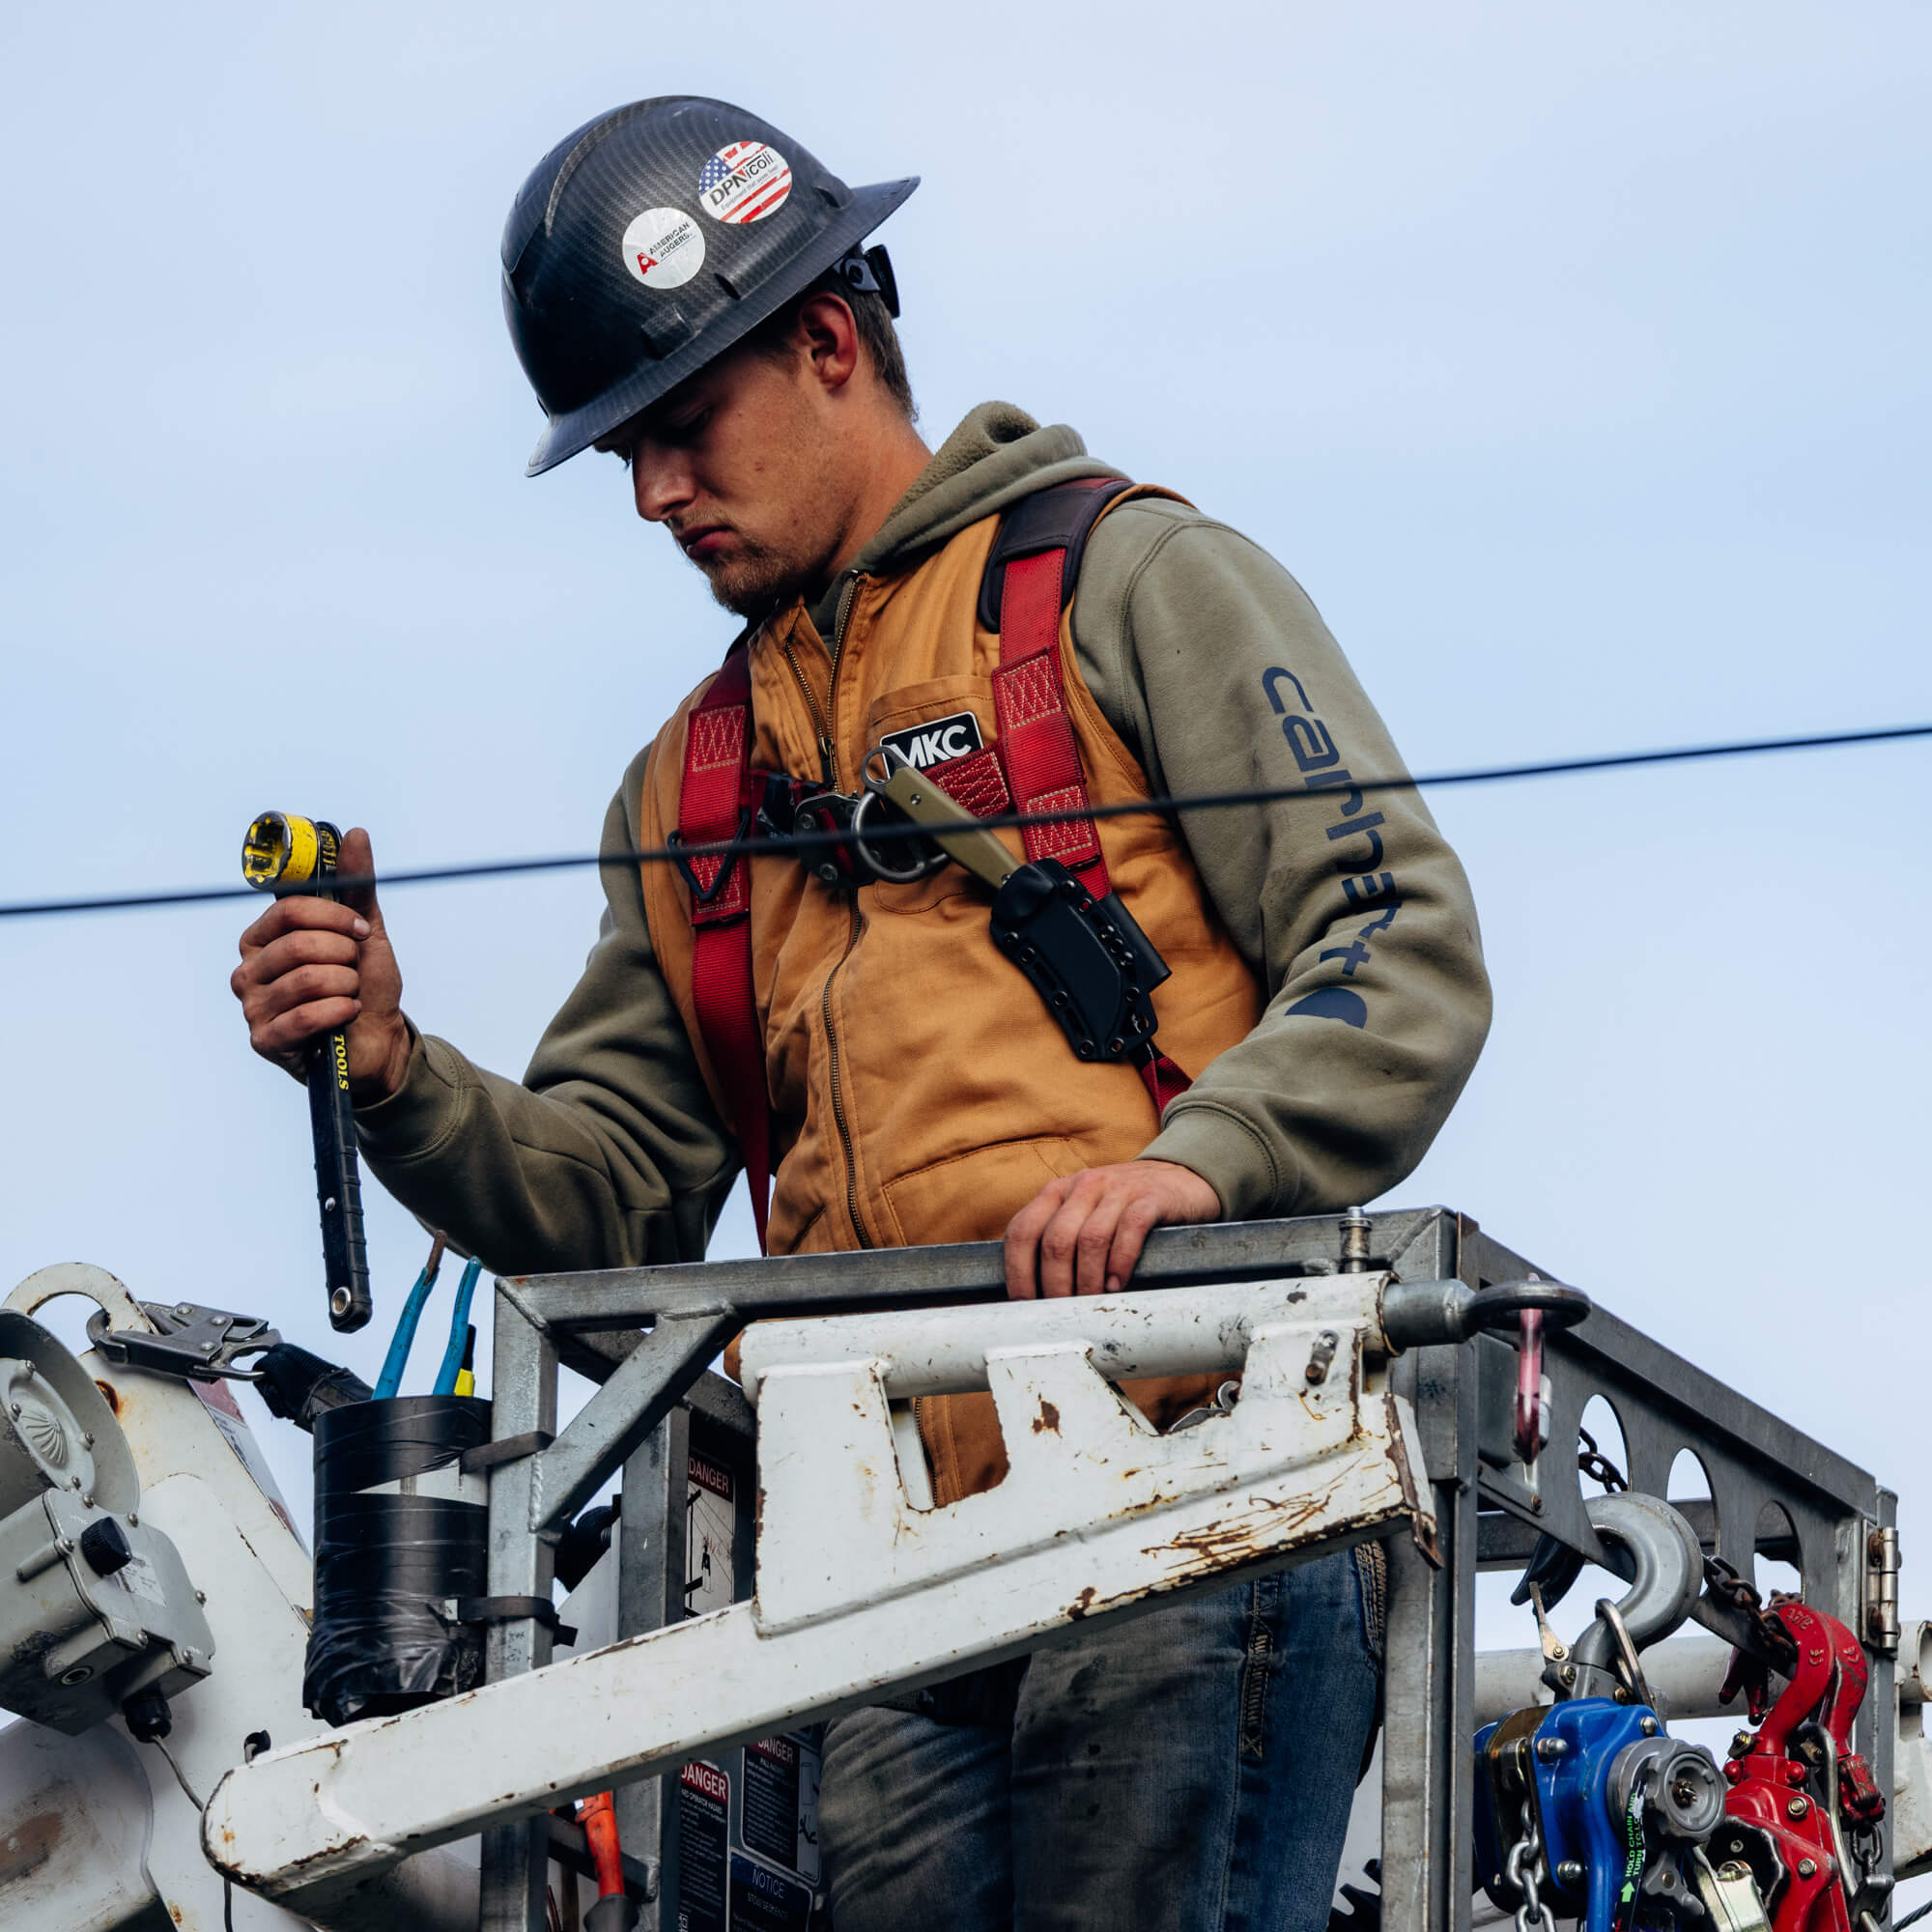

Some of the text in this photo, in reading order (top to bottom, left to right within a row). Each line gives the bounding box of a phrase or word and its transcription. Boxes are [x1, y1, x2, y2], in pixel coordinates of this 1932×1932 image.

[709, 151, 774, 206] DPNicoli
[649, 222, 690, 256] AMERICAN
[660, 233, 690, 258] AUGERS
[333, 1034, 349, 1091] TOOLS
[688, 1456, 729, 1493] DANGER
[1626, 1815, 1635, 1847] CHAIN
[1625, 1850, 1636, 1877] HOLD
[1633, 1849, 1643, 1876] TURN
[752, 1868, 785, 1899] NOTICE
